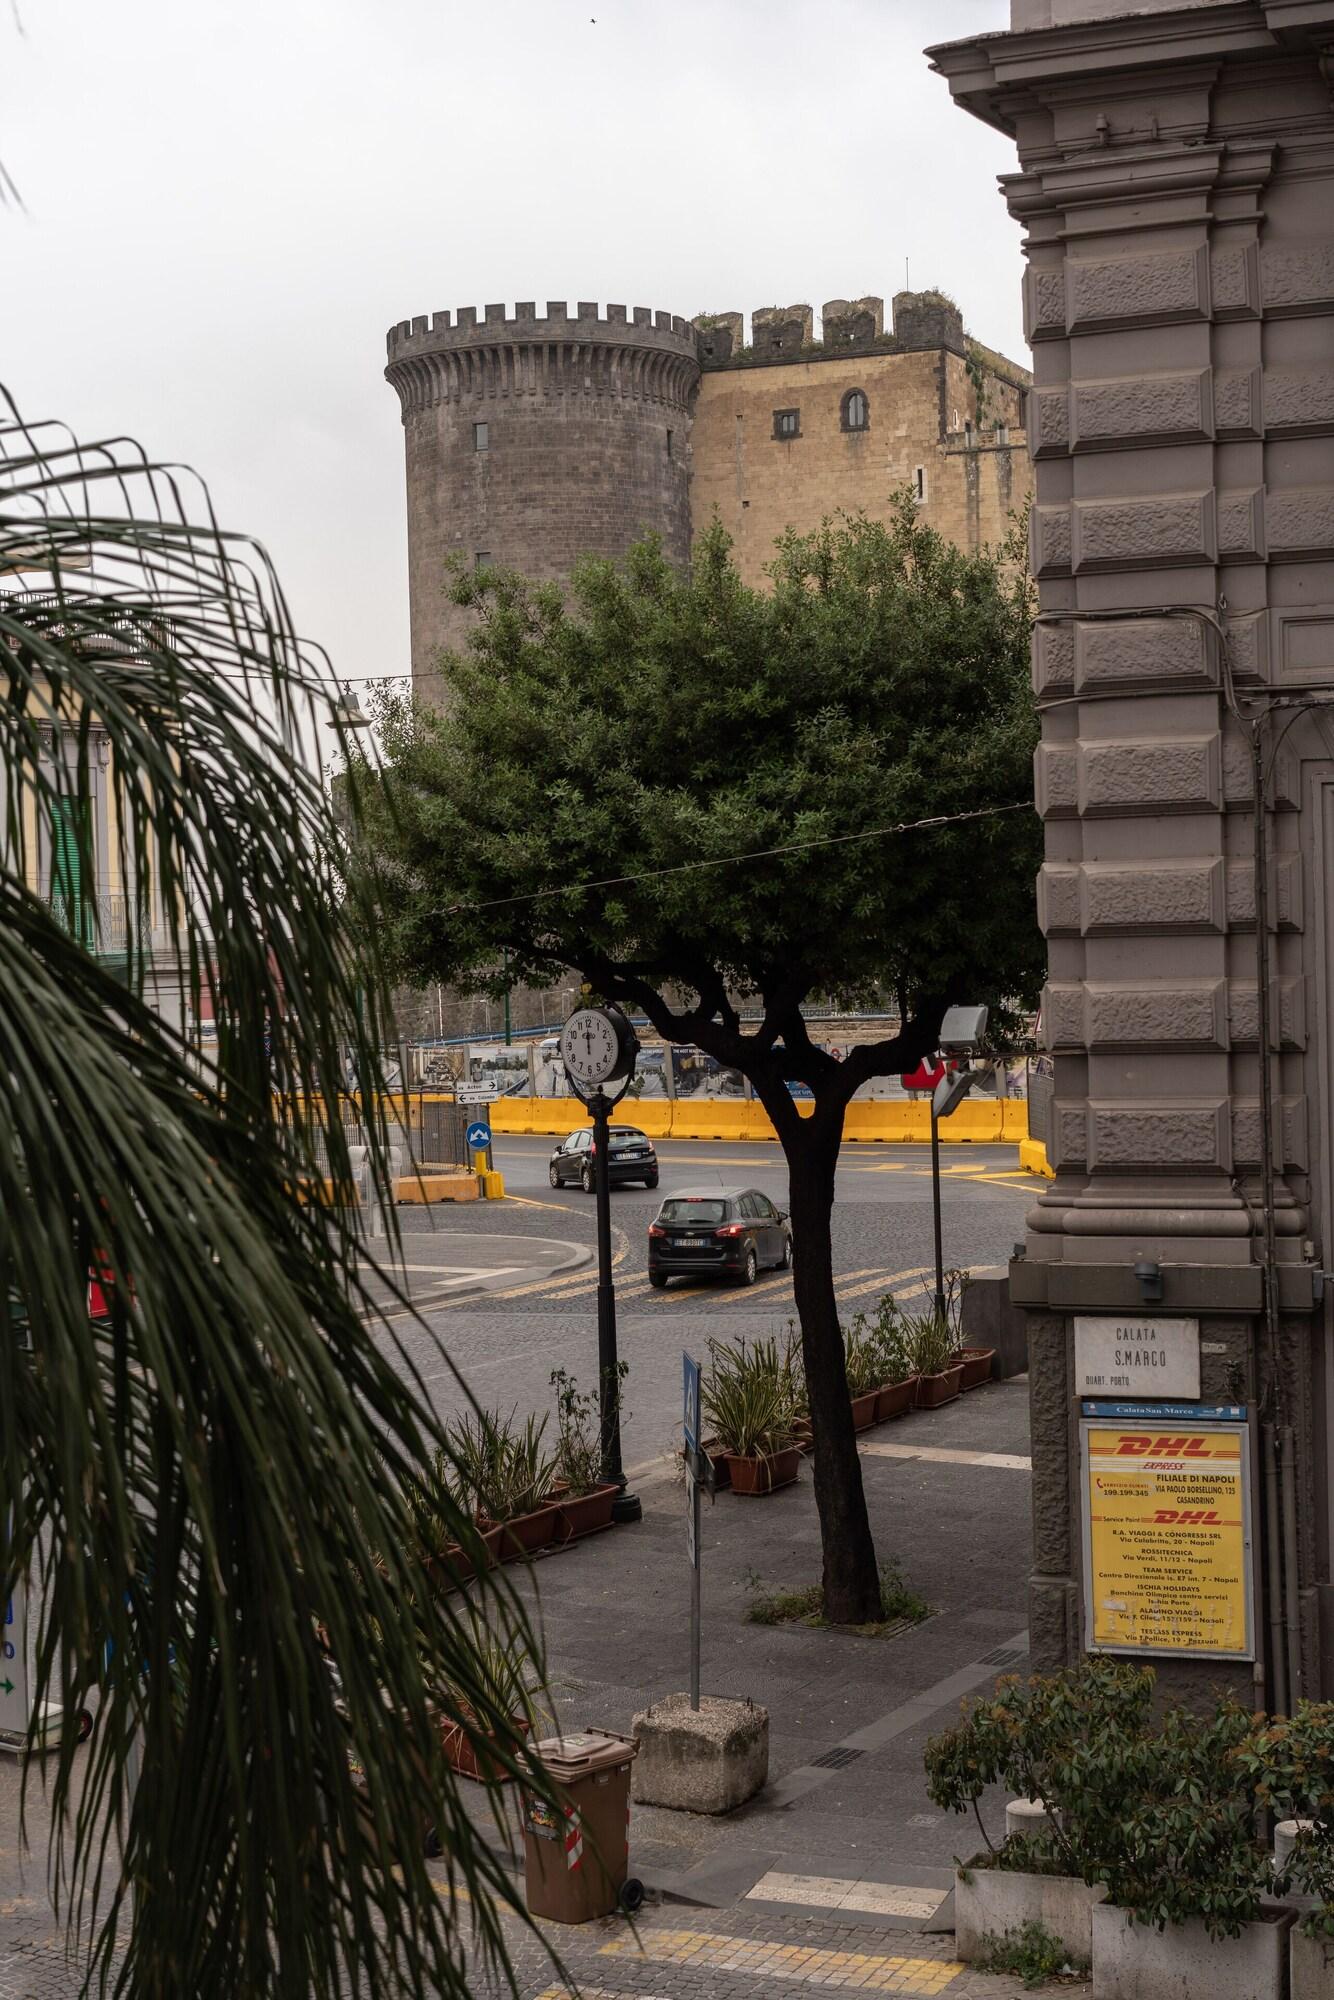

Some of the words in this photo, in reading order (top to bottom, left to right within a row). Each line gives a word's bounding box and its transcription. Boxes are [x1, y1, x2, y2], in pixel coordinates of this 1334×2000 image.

[586, 1020, 592, 1028] 12
[570, 1031, 577, 1039] 10
[603, 1030, 607, 1039] 2
[568, 1042, 572, 1051] 9
[607, 1043, 611, 1052] 3
[571, 1054, 576, 1062] 8
[579, 1062, 584, 1070] 7
[588, 1065, 592, 1074] 6
[596, 1062, 601, 1071] 5
[1116, 1328, 1156, 1341] CALATA
[1115, 1350, 1166, 1367] S.MARCO
[1110, 1376, 1129, 1386] PORTO
[1117, 1436, 1211, 1457] DHL
[1144, 1462, 1185, 1470] EXPRESS
[1187, 1486, 1224, 1495] BORSELLINO,
[1152, 1510, 1223, 1525] DHL
